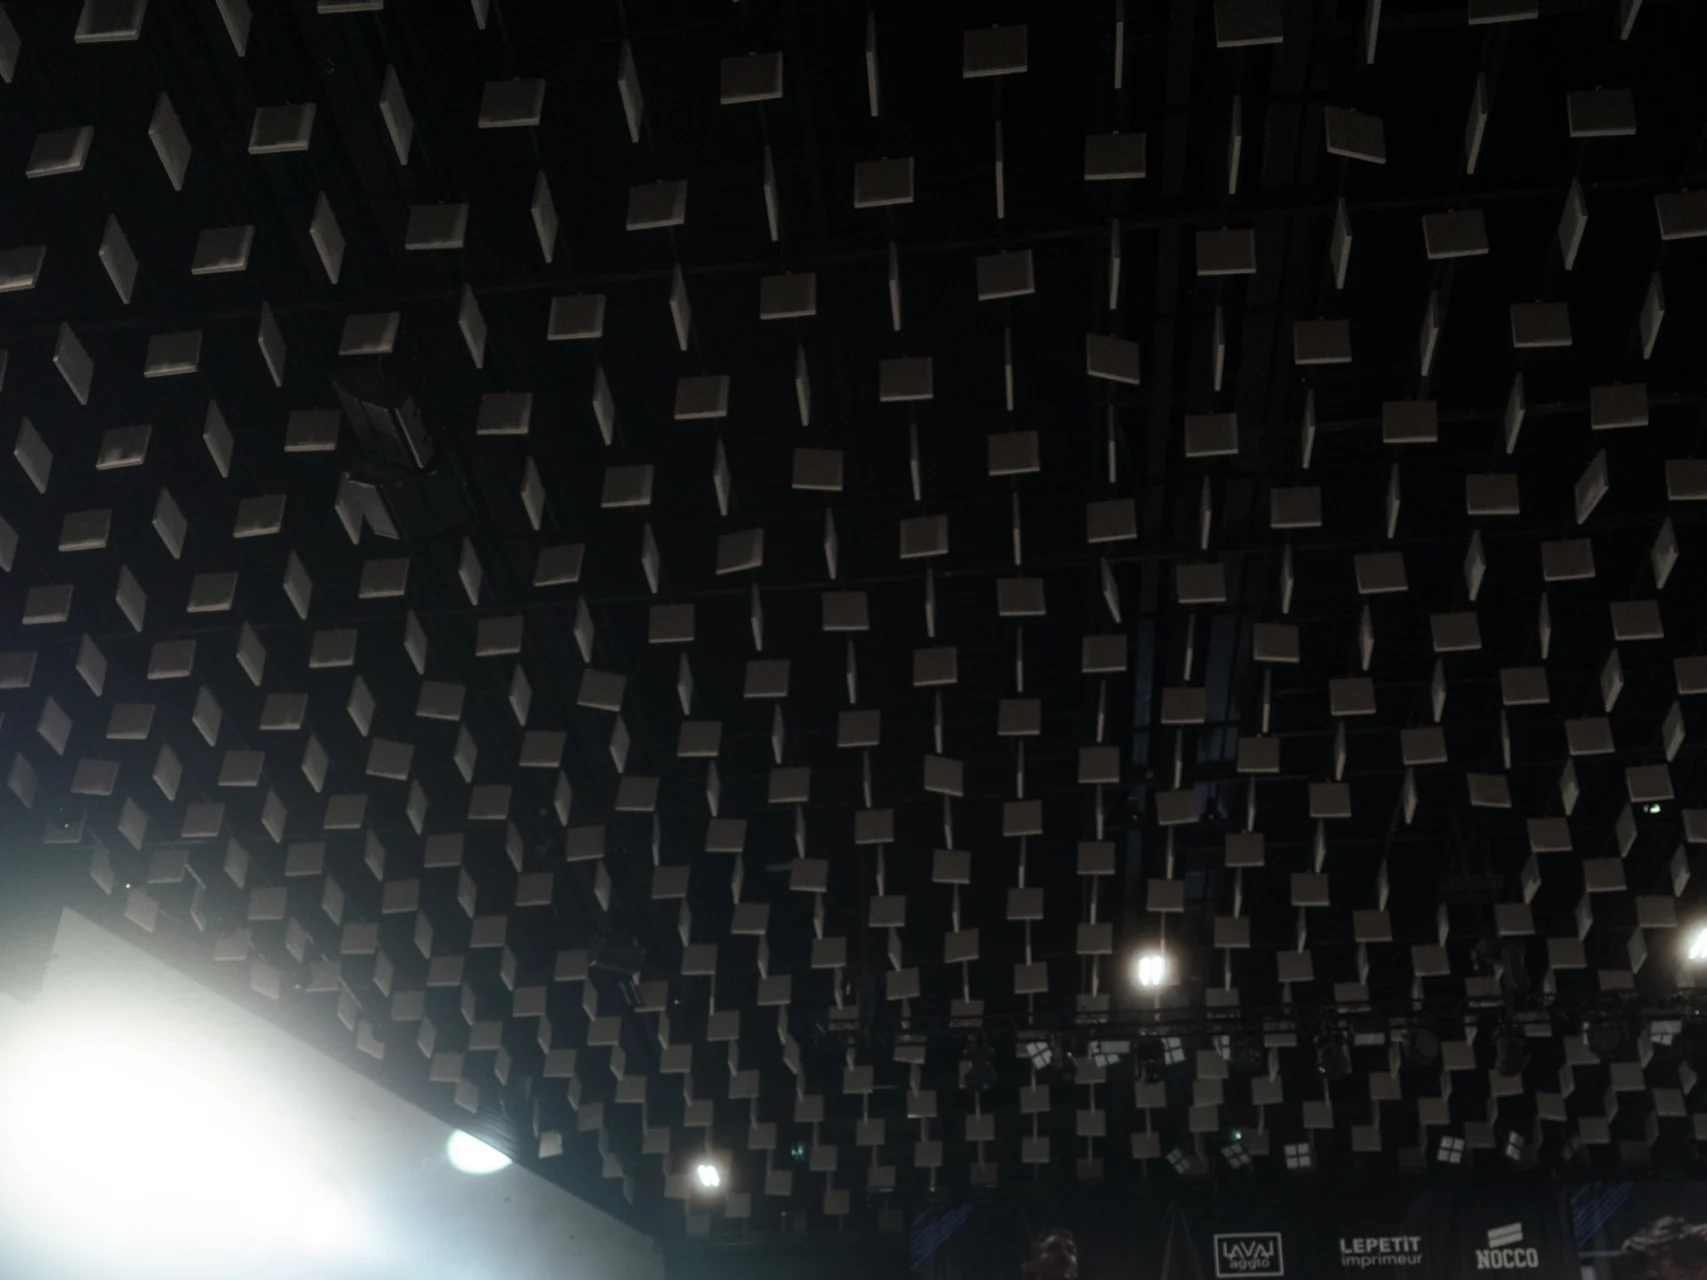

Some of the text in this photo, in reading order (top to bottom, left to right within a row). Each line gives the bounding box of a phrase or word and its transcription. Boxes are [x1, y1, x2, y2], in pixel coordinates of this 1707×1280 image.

[1340, 1236, 1421, 1254] LEPETIT
[1229, 1258, 1270, 1270] agglo
[1341, 1253, 1423, 1270] imprimeur
[1476, 1248, 1539, 1270] NOCCO
